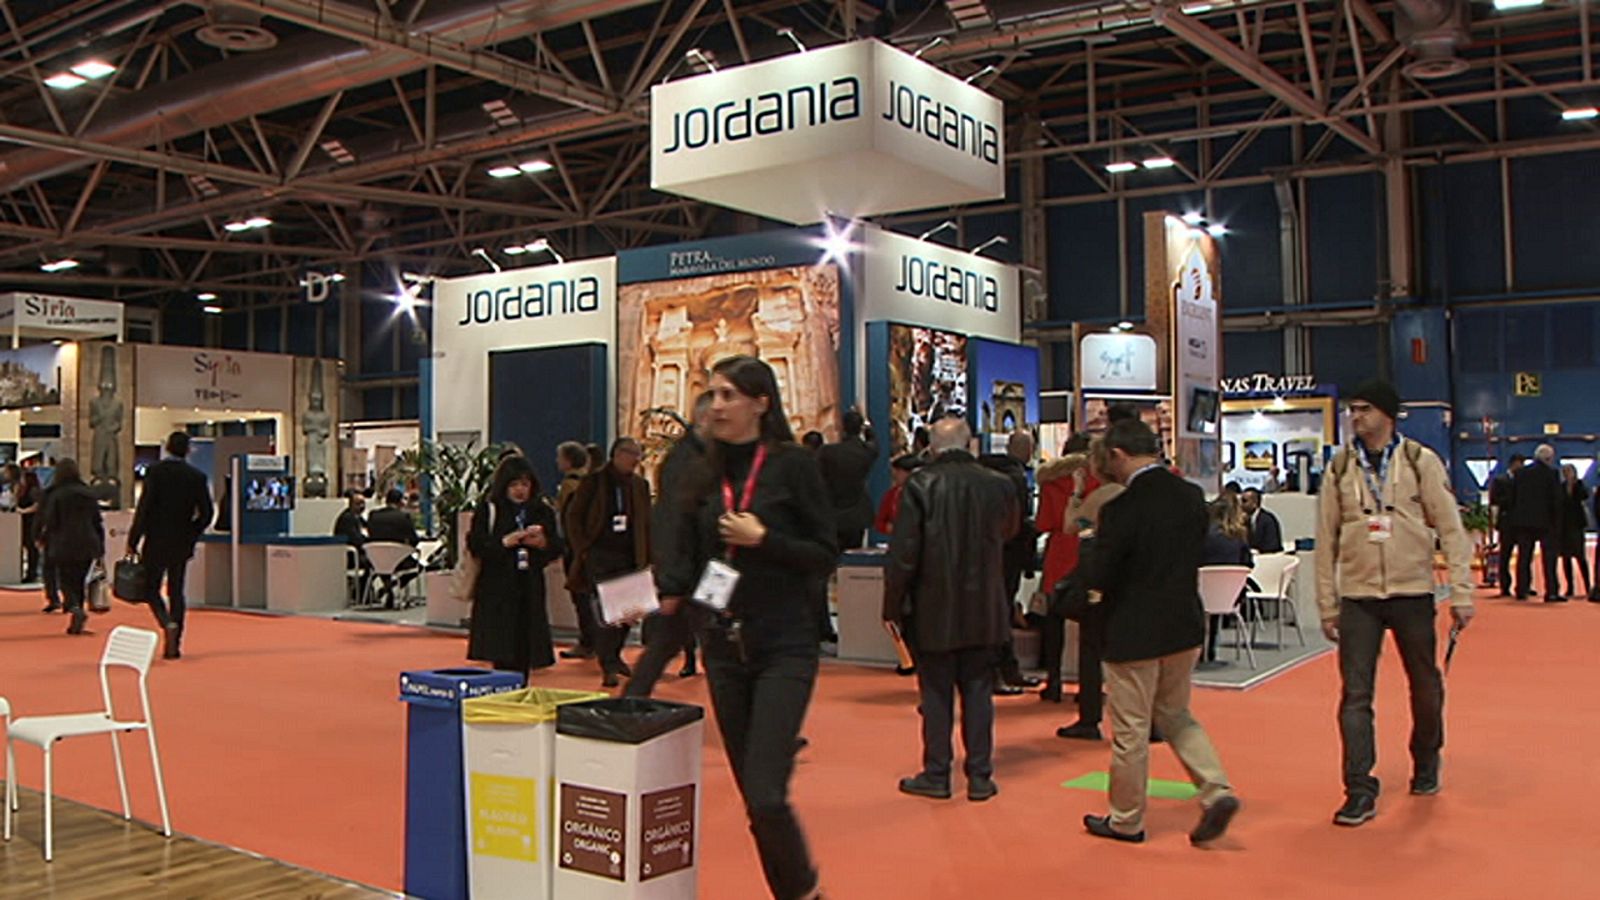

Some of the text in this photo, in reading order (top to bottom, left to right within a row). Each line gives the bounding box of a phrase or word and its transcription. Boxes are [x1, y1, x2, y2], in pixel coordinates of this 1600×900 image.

[738, 254, 775, 267] MUNDO
[306, 271, 329, 302] D
[25, 295, 76, 318] Siria
